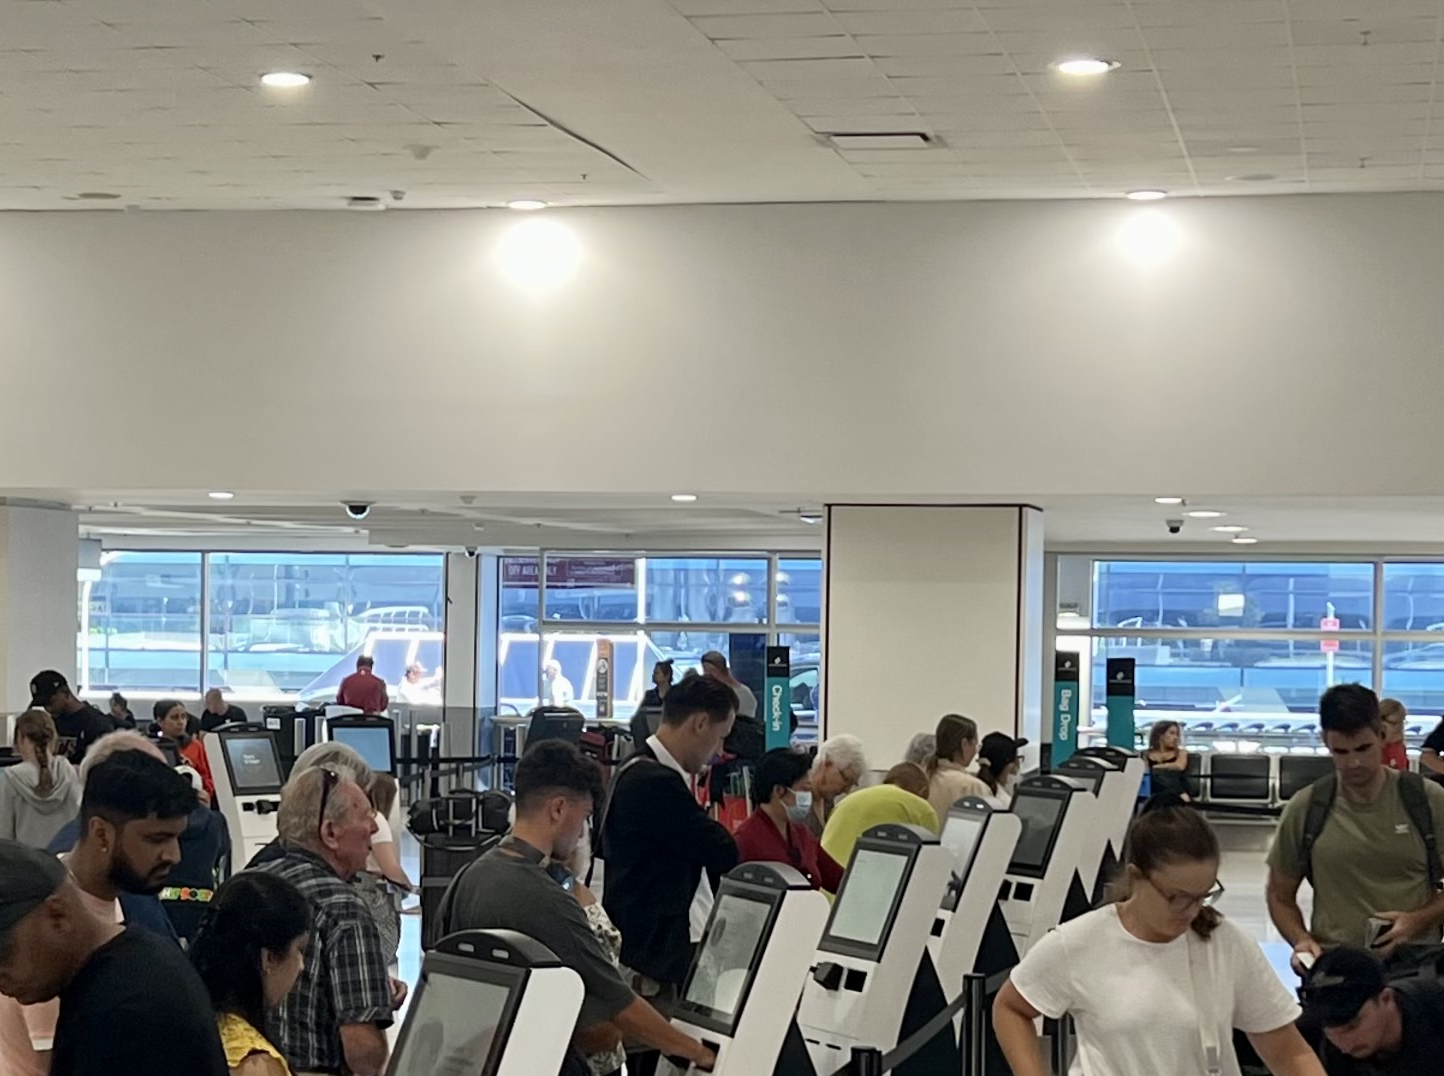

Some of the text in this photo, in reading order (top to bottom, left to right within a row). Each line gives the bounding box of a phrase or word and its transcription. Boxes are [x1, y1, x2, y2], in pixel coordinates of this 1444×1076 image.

[772, 684, 783, 732] Check-in
[1058, 689, 1072, 741] Bag Drop
